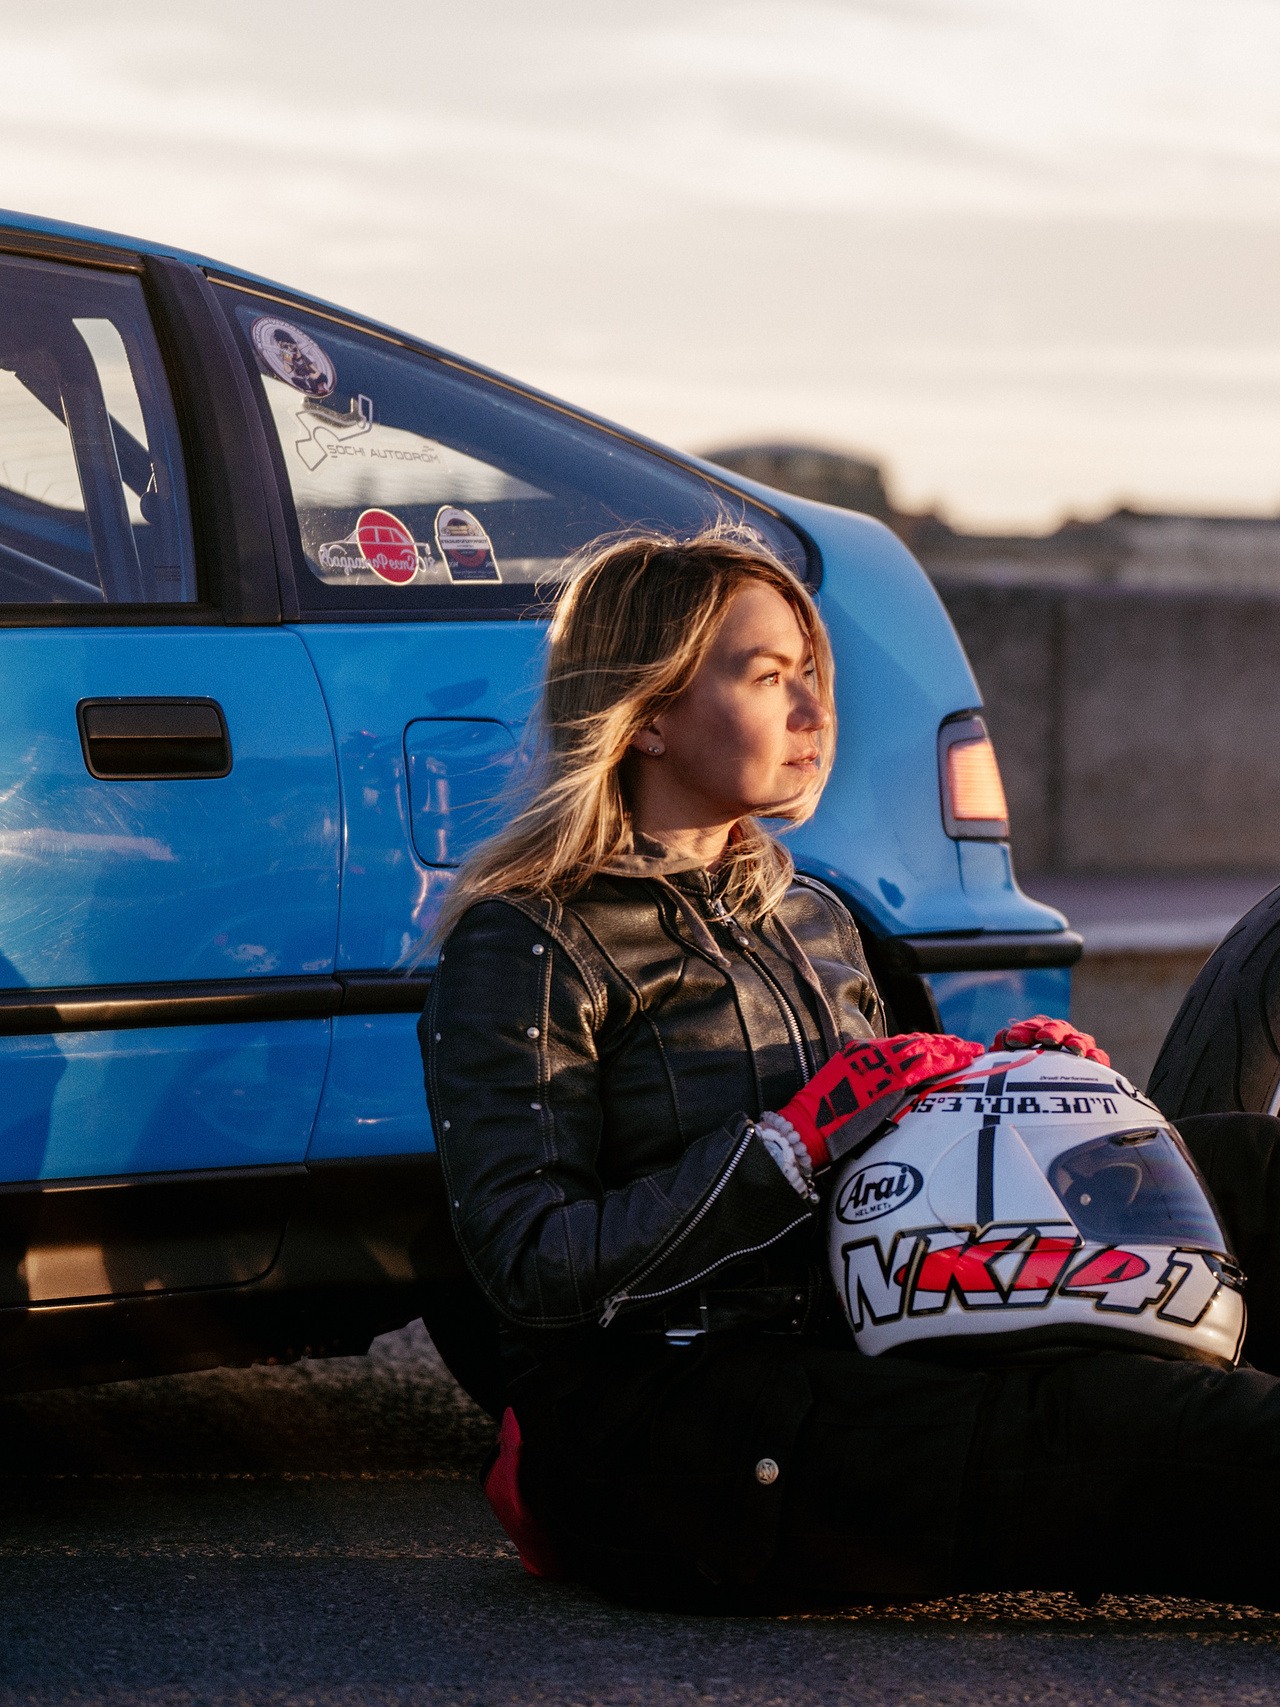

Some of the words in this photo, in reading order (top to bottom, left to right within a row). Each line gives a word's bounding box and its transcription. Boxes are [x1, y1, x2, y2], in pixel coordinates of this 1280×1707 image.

[326, 445, 366, 457] SOCHI
[370, 448, 441, 463] AUTODROM
[840, 1165, 910, 1216] Arai
[854, 1202, 889, 1217] HELMET
